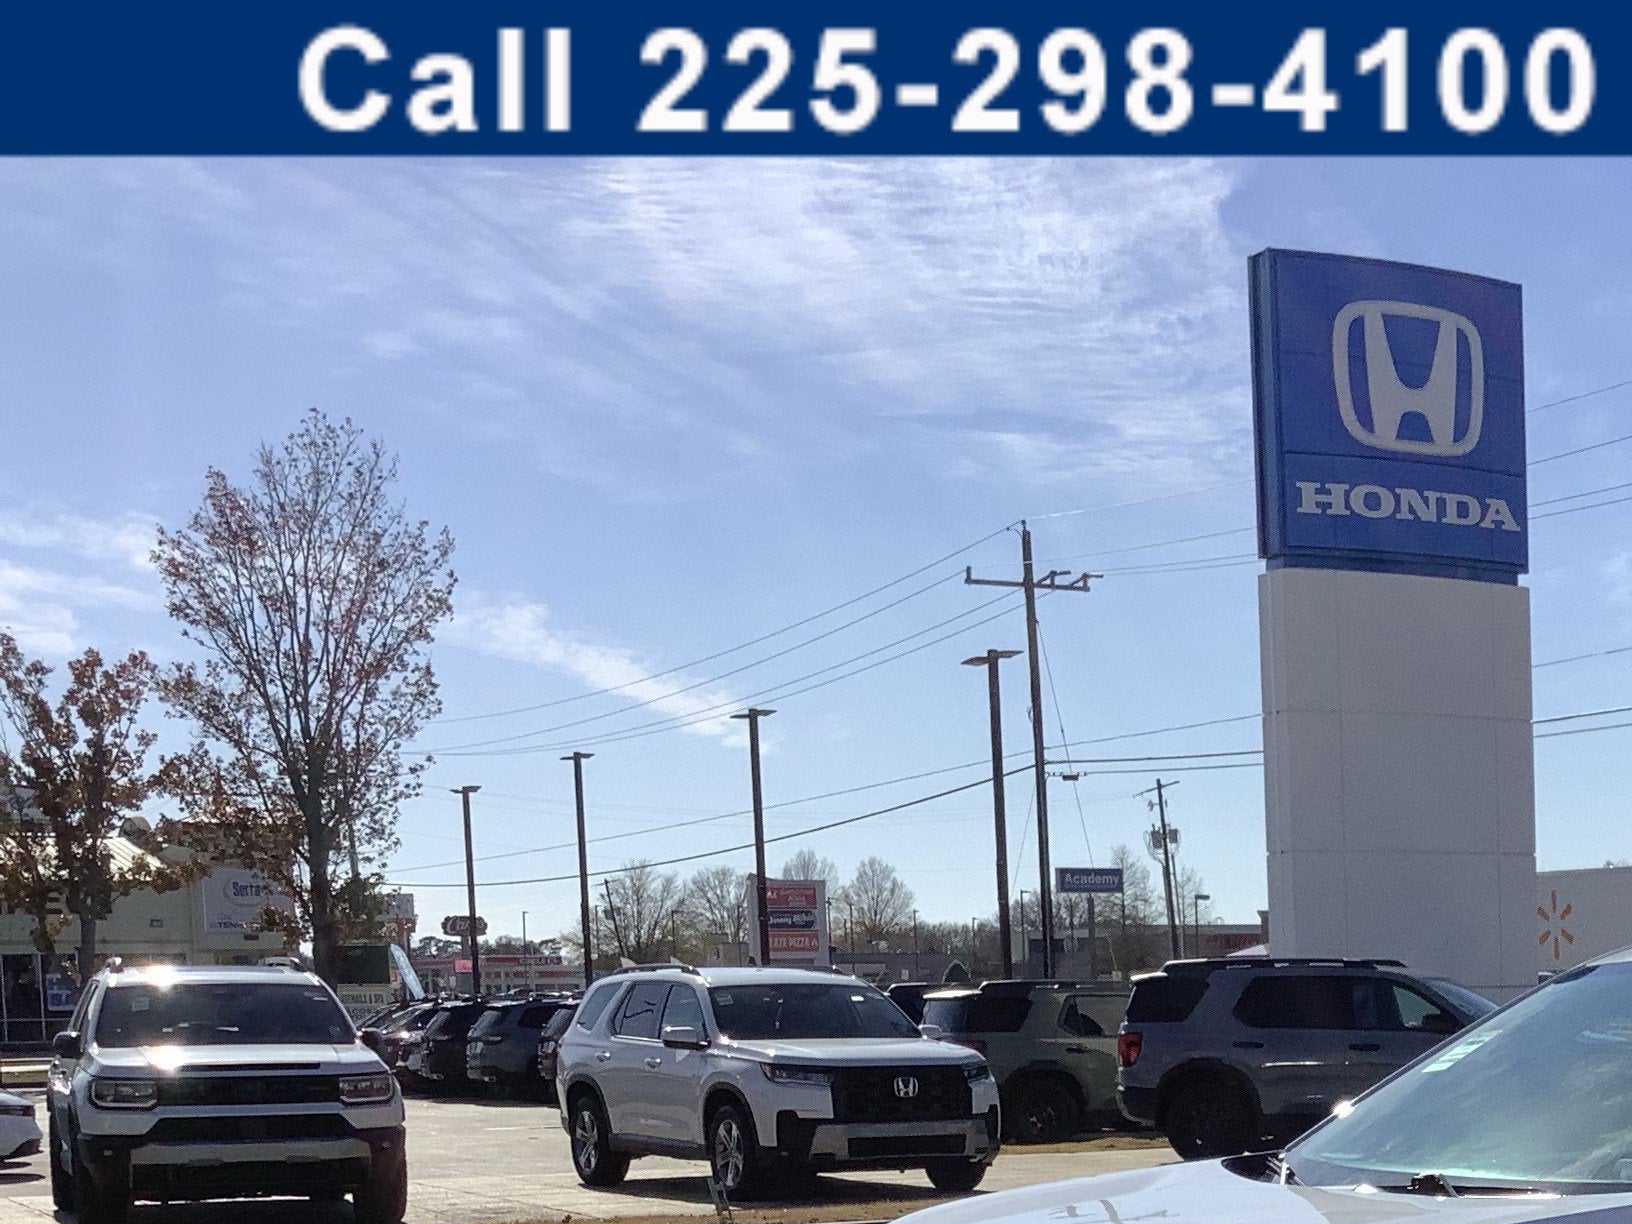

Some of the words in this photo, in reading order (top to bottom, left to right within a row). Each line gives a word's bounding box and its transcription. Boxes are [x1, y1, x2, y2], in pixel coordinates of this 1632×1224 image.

[1296, 481, 1521, 531] HONDA
[1064, 872, 1120, 887] Academy
[232, 881, 262, 897] Serta
